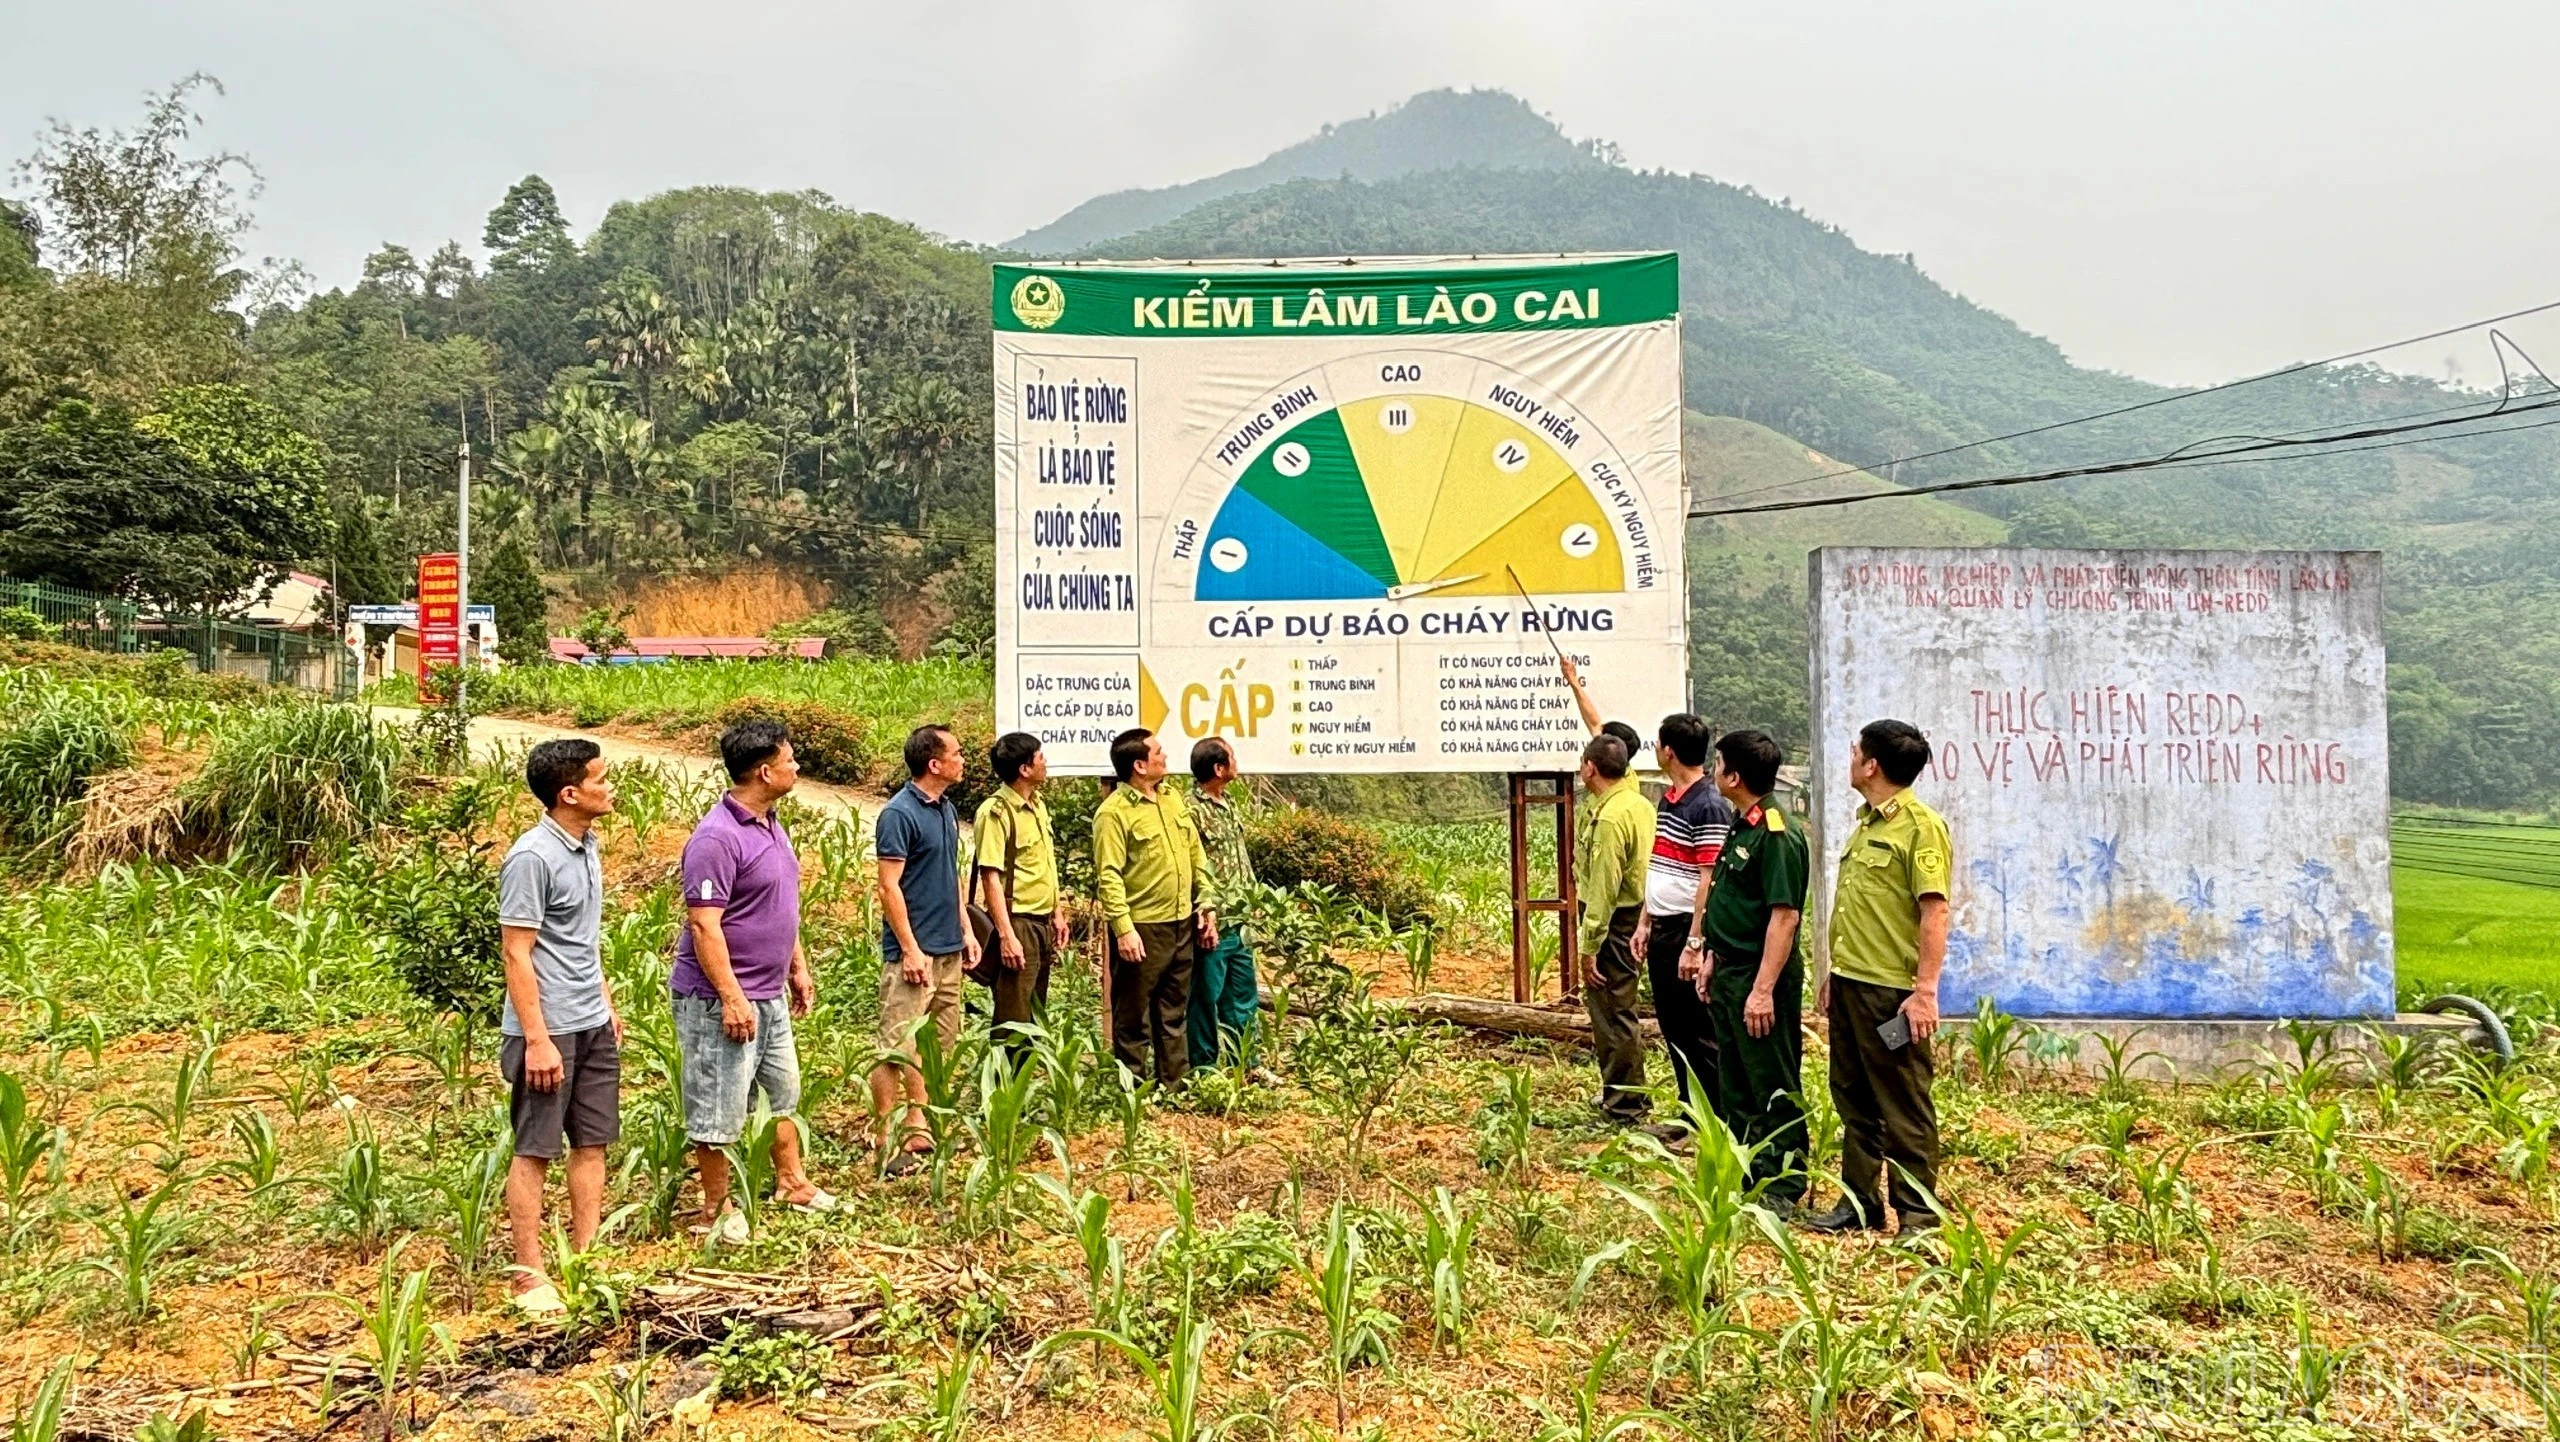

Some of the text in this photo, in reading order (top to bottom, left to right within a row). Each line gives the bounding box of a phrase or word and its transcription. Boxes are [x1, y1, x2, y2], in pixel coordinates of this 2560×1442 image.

[1134, 278, 1600, 329] KIỂM LÂM LÀO CAI
[1381, 365, 1421, 382] CAO
[1026, 368, 1126, 431] BẢO VỆ RỪNG
[1216, 385, 1318, 467] TRUNG BÌNH
[1389, 409, 1407, 426] III
[1489, 384, 1580, 450] NGUY HIỂM
[1039, 432, 1115, 495] LÀ BẢO VỆ
[1499, 445, 1525, 466] IV
[1034, 498, 1121, 556] CUỘC SỐNG
[1591, 462, 1663, 589] CỰC KỲ NGUY HIỂM
[1173, 519, 1198, 560] THẤP
[1571, 531, 1591, 547] V
[1023, 556, 1134, 611] CỦA CHÚNG TA
[2146, 563, 2188, 589] NÔNG
[1905, 588, 1938, 608] BAN
[2187, 592, 2269, 613] UN-REDD
[1208, 603, 1614, 644] CẤP DỰ BÁO CHÁY RỪNG
[1308, 655, 1338, 670] THẤP
[1452, 654, 1468, 668] CÓ
[1471, 657, 1503, 668] NGUY
[1506, 656, 1522, 667] CƠ
[1525, 653, 1556, 667] CHÁY
[1026, 671, 1132, 696] ĐẶC TRƯNG CỦA
[1308, 679, 1346, 691] TRUNG
[1440, 675, 1456, 689] CÓ
[1459, 673, 1482, 689] KHẢ
[1485, 674, 1518, 689] NĂNG
[1520, 674, 1551, 688] CHÁY
[1024, 697, 1134, 722] CÁC CẤP DỰ BÁO
[1180, 658, 1275, 739] CẤP
[1308, 701, 1333, 712] CAO
[1440, 696, 1456, 710] CÓ
[1459, 694, 1482, 710] KHẢ
[1485, 696, 1518, 710] NĂNG
[1539, 695, 1570, 709] CHÁY
[1309, 722, 1341, 733] NGUY
[1344, 715, 1371, 733] HIỂM
[1440, 716, 1578, 732] CÓ KHẢ NĂNG CHÁY LỚN
[1970, 685, 2261, 740] THỰC HIỆN REDD+
[1041, 725, 1117, 743] CHÁY RỪNG
[1293, 744, 1301, 755] V
[1309, 743, 1333, 758] CỰC
[1353, 743, 1385, 754] NGUY
[1388, 735, 1416, 753] HIỂM
[1441, 739, 1457, 753] CÓ
[1460, 737, 1483, 753] KHẢ
[1486, 738, 1519, 752] NĂNG
[1522, 738, 1553, 752] CHÁY
[1556, 738, 1579, 752] LỚN
[1972, 736, 2013, 788] VỆ
[2026, 734, 2069, 782] VÀ
[2080, 737, 2148, 784] PHÁT
